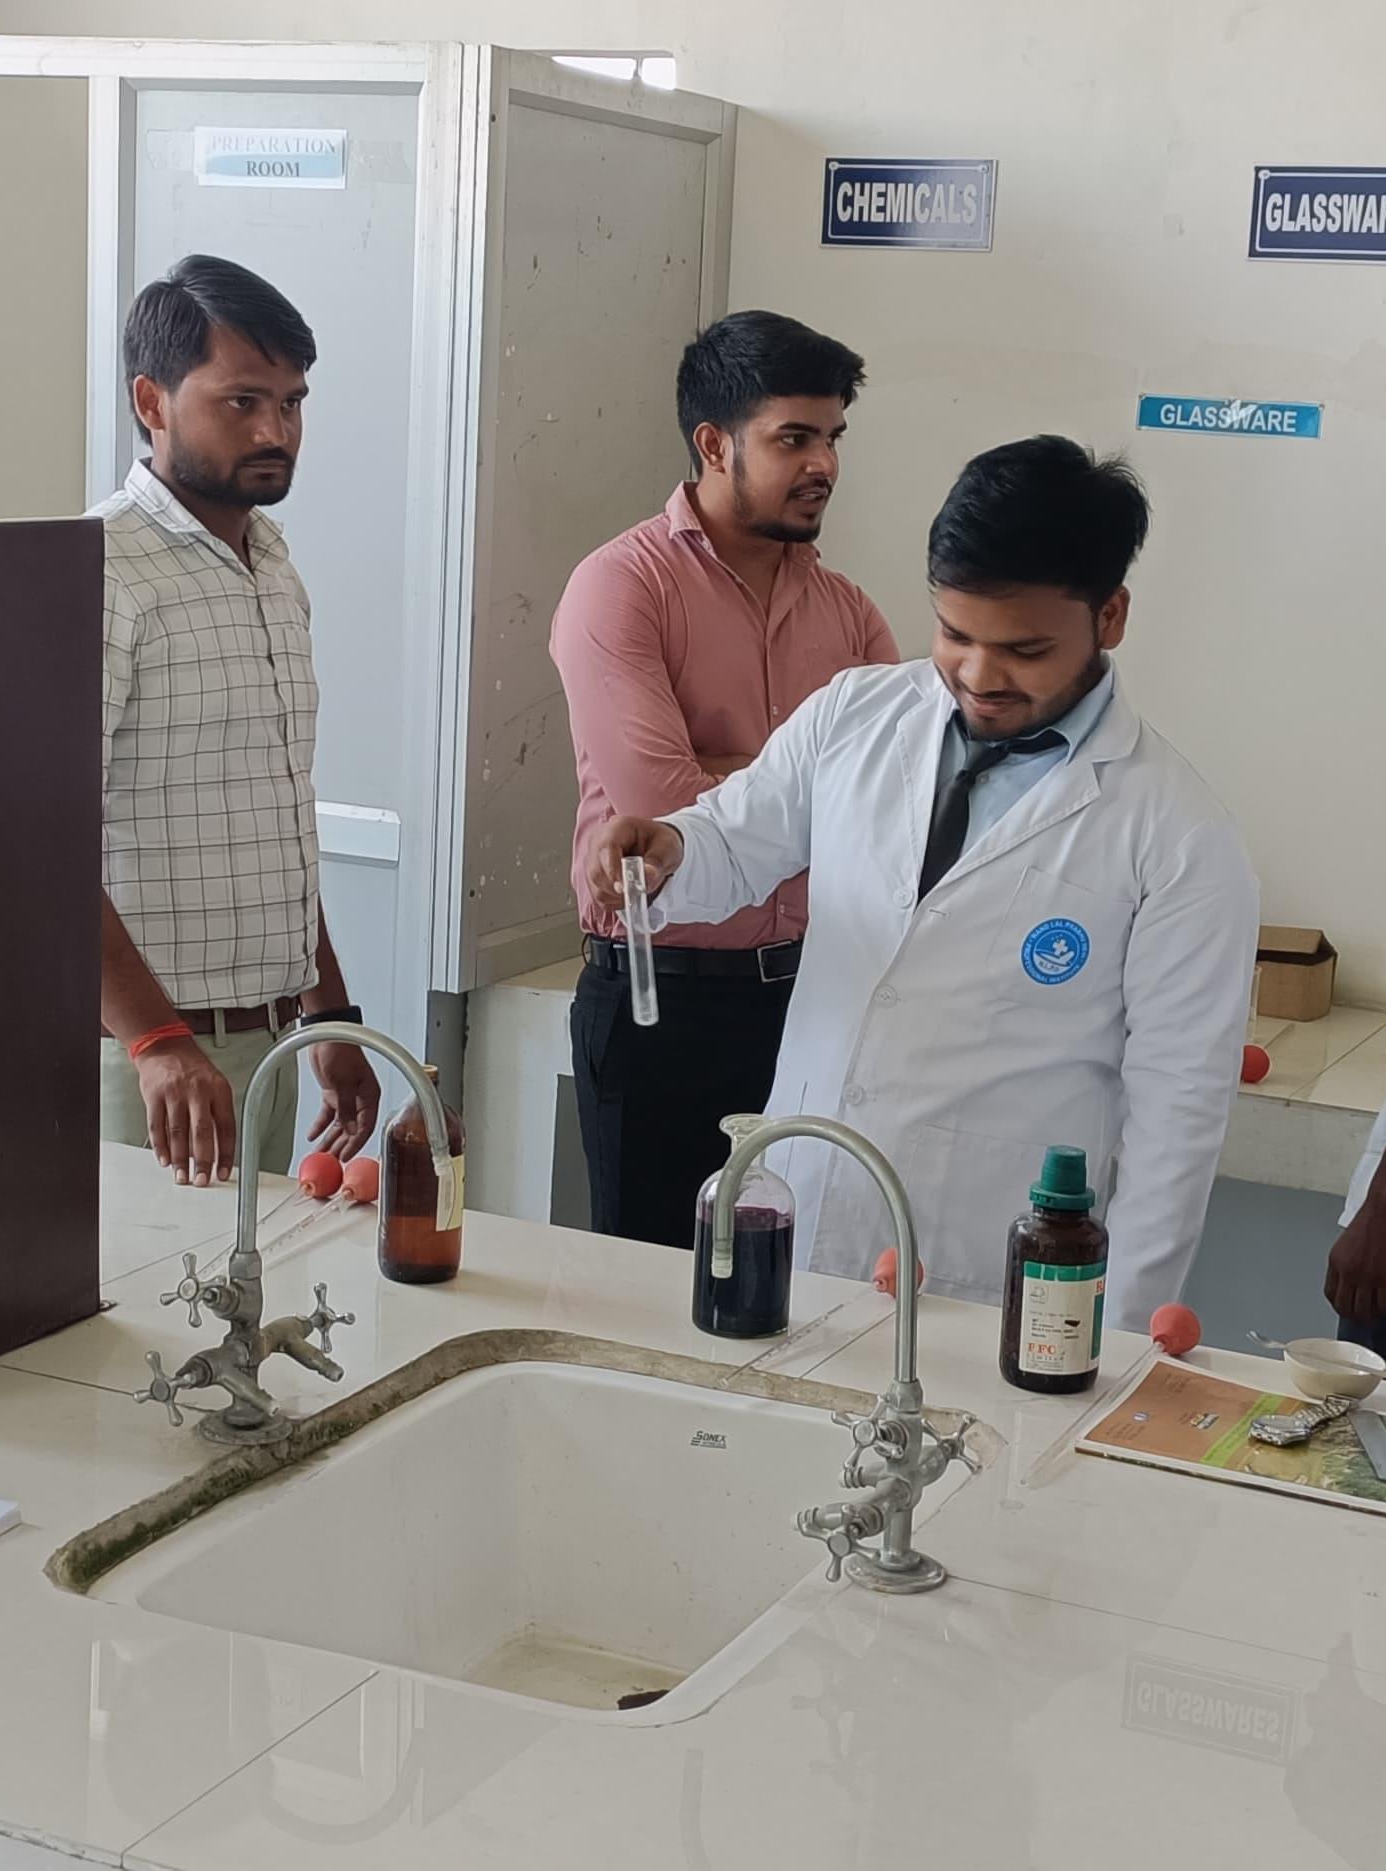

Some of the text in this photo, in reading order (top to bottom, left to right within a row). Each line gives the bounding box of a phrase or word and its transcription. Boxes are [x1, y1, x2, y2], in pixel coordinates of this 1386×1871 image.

[212, 135, 336, 153] PREPARATION
[246, 160, 301, 177] ROOM
[836, 181, 978, 224] CHEMICALS
[1160, 403, 1297, 433] GLASSWARE
